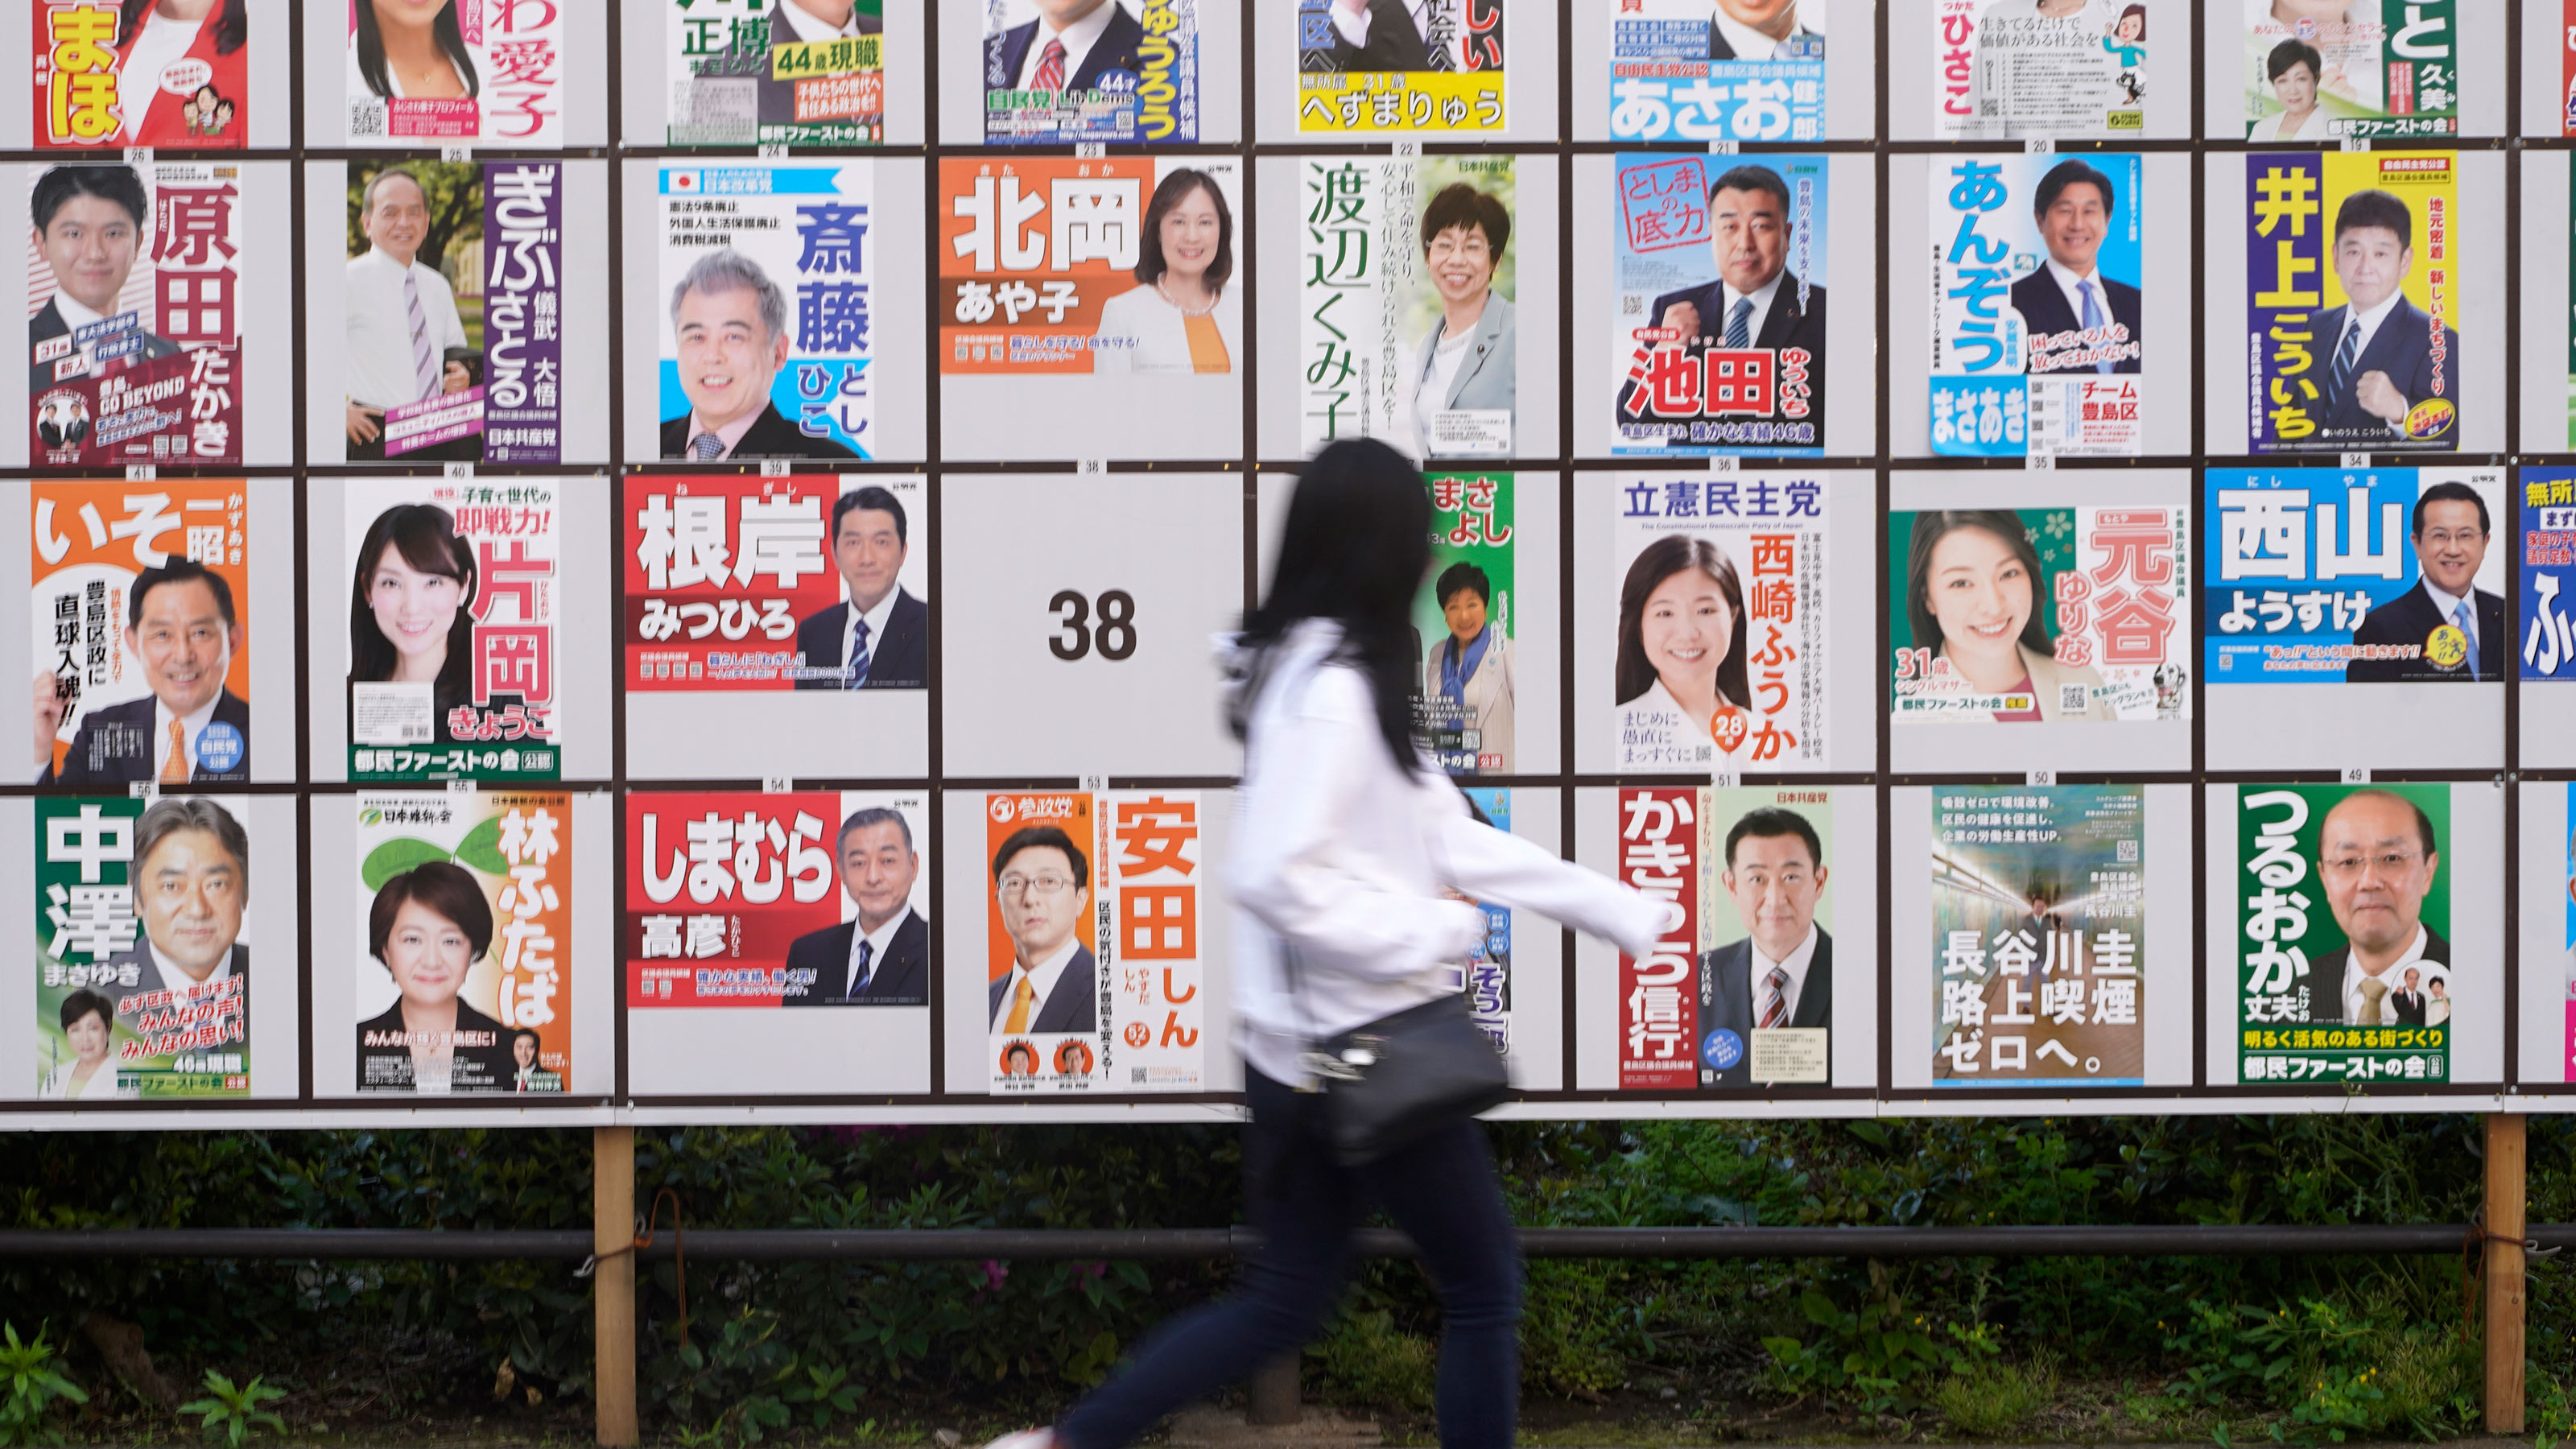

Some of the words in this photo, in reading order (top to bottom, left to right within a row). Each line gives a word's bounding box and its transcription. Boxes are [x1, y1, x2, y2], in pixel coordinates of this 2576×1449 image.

[682, 16, 773, 56] 正博
[1979, 16, 2081, 31] 生きてるだけで
[1979, 32, 2099, 48] 価値がある社会を
[487, 0, 557, 138] わ愛子
[777, 38, 879, 73] 44歳現職
[1942, 14, 1975, 115] ひさこ
[50, 5, 120, 138] まほ
[1301, 73, 1347, 90] 無所属
[1363, 73, 1406, 90] 31歳
[1614, 64, 1709, 78] 自由民主党公認
[1711, 64, 1822, 79] 豊島区議会議員候補
[1088, 89, 1135, 106] Dems
[2420, 64, 2447, 111] 久美
[1301, 89, 1503, 129] へずまりゅう
[1611, 78, 1792, 141] あさお
[759, 125, 869, 141] 都民ファーストの会
[2327, 118, 2448, 134] 都民ファーストの会
[131, 150, 146, 163] 26
[449, 149, 462, 162] 25
[767, 145, 780, 158] 24
[1084, 144, 1096, 157] 23
[1400, 143, 1413, 155] 22
[1716, 142, 1729, 155] 21
[2033, 142, 2046, 153] 20
[2351, 138, 2362, 151] 19
[1458, 161, 1509, 173] 日本共産党
[2383, 159, 2446, 170] 自由民主党公認
[1629, 165, 1699, 200] としま
[669, 200, 740, 214] 憲法9条廃止
[1662, 196, 1678, 211] の
[489, 164, 557, 292] ぎぶ
[669, 216, 781, 230] 外国人生活保護廃止
[952, 176, 1141, 272] 北岡
[1399, 163, 1415, 287] 平和で命を守り、
[1633, 204, 1705, 246] 底力
[2255, 167, 2319, 308] 井上
[2429, 196, 2445, 260] 地元密着
[669, 233, 732, 247] 消費税減税
[151, 182, 238, 349] 原田
[795, 200, 869, 353] 斎藤
[1947, 160, 2010, 373] あんぞう
[533, 291, 557, 341] 儀武
[955, 280, 1080, 324] あや子
[1306, 160, 1371, 443] 渡辺くみ子
[2029, 324, 2129, 352] 困っている人を
[2429, 270, 2445, 395] 新しいまちづくり
[489, 291, 529, 409] さとる
[2033, 342, 2140, 371] 放っておかない!
[533, 357, 557, 409] 大悟
[1624, 345, 1776, 419] 池田
[1779, 346, 1811, 419] ゆういち
[2082, 380, 2137, 399] チーム
[2268, 313, 2319, 440] こういち
[122, 375, 185, 411] BEYOND
[190, 348, 232, 457] たかき
[797, 363, 832, 438] ひこ
[838, 364, 869, 436] とし
[1933, 386, 2027, 445] まさあき
[2082, 402, 2139, 421] 豊島区
[488, 427, 556, 446] 日本共産党
[1620, 423, 1688, 440] 豊島区生まれ
[1690, 421, 1816, 444] 確かな実績46歳
[134, 467, 146, 481] 41
[452, 465, 465, 477] 40
[769, 461, 782, 474] 39
[1086, 460, 1099, 473] 38
[1718, 458, 1731, 471] 36
[2034, 456, 2047, 469] 35
[2349, 454, 2362, 466] 34
[462, 486, 551, 504] 子育て世代の
[675, 482, 688, 497] ね
[1433, 477, 1499, 511] まさ
[2247, 475, 2282, 489] にし
[2343, 475, 2378, 489] やま
[1623, 479, 1822, 518] 立憲民主党
[35, 492, 183, 569] いそ
[185, 499, 225, 565] 一昭
[227, 492, 243, 566] かずあき
[453, 507, 551, 537] 即戦力!
[1447, 511, 1513, 547] よし
[1641, 522, 1654, 531] The
[1657, 522, 1707, 531] Constitutional
[1709, 522, 1750, 531] Democratic
[1751, 522, 1771, 531] Party
[1773, 522, 1781, 531] of
[1782, 522, 1803, 531] Japan
[2218, 486, 2404, 581] 西山
[636, 493, 827, 591] 根岸
[2091, 509, 2176, 665] 元谷
[467, 539, 554, 707] 片岡
[639, 598, 797, 642] みつひろ
[1048, 588, 1137, 661] 38
[2054, 570, 2091, 668] ゆりな
[2218, 589, 2372, 634] ようすけ
[87, 579, 106, 688] 豊島区政に
[1749, 534, 1798, 762] 西崎ふうか
[55, 592, 80, 728] 直球入魂!!
[1895, 646, 1951, 679] 31歳
[1895, 678, 1973, 694] シングルマザー
[1623, 711, 1679, 726] まじめに
[1902, 696, 2002, 711] 都民ファーストの会
[447, 704, 554, 742] きょうこ
[1622, 729, 1672, 745] 愚直に
[1715, 714, 1744, 736] 28
[200, 738, 237, 755] 自民党
[354, 748, 519, 773] 都民ファーストの会
[524, 753, 551, 770] 公認
[1479, 753, 1502, 768] 公認
[1624, 745, 1690, 764] まっすぐに
[454, 781, 468, 793] 55
[771, 778, 784, 791] 54
[1087, 776, 1100, 789] 53
[1718, 774, 1731, 786] 51
[2035, 772, 2048, 784] 50
[2348, 769, 2363, 781] 49
[492, 795, 566, 807] 日本維新の会公認
[1776, 792, 1828, 804] 日本共産党
[385, 809, 452, 827] 日本維新の会
[1941, 813, 2054, 827] 区民の健康を促進し、
[1942, 829, 2062, 843] 企業の労働生産性UP。
[642, 809, 834, 905] しまむら
[46, 804, 138, 961] 中澤
[1116, 795, 1198, 961] 安田
[2090, 872, 2138, 882] 豊島区議会
[2244, 790, 2311, 994] つるおか
[498, 807, 559, 1027] 林ふたば
[2084, 903, 2137, 918] 長谷川圭
[641, 913, 726, 959] 高彦
[1941, 927, 2137, 976] 長谷川圭
[43, 962, 142, 988] まさゆき
[696, 968, 818, 985] 確かな実績、働く男!
[1124, 968, 1136, 993] しん
[1138, 968, 1150, 1005] やすだ
[118, 972, 244, 1016] 必ず区政へ届けます!
[1159, 966, 1199, 1049] しん
[1941, 978, 2137, 1026] 路上喫煙
[2244, 993, 2298, 1023] 丈夫
[2297, 985, 2310, 1022] たけお
[138, 994, 243, 1033] みんなの声!
[1629, 986, 1682, 1059] 信行
[121, 1017, 243, 1061] みんなの思い!
[1128, 1025, 1146, 1041] 52
[2244, 1029, 2443, 1049] 明るく活気のある街づくり
[1941, 1028, 2101, 1073] ゼロへ。
[118, 1075, 223, 1088] 都民ファーストの会
[226, 1076, 247, 1089] 公認
[2244, 1055, 2426, 1080] 都民ファーストの会
